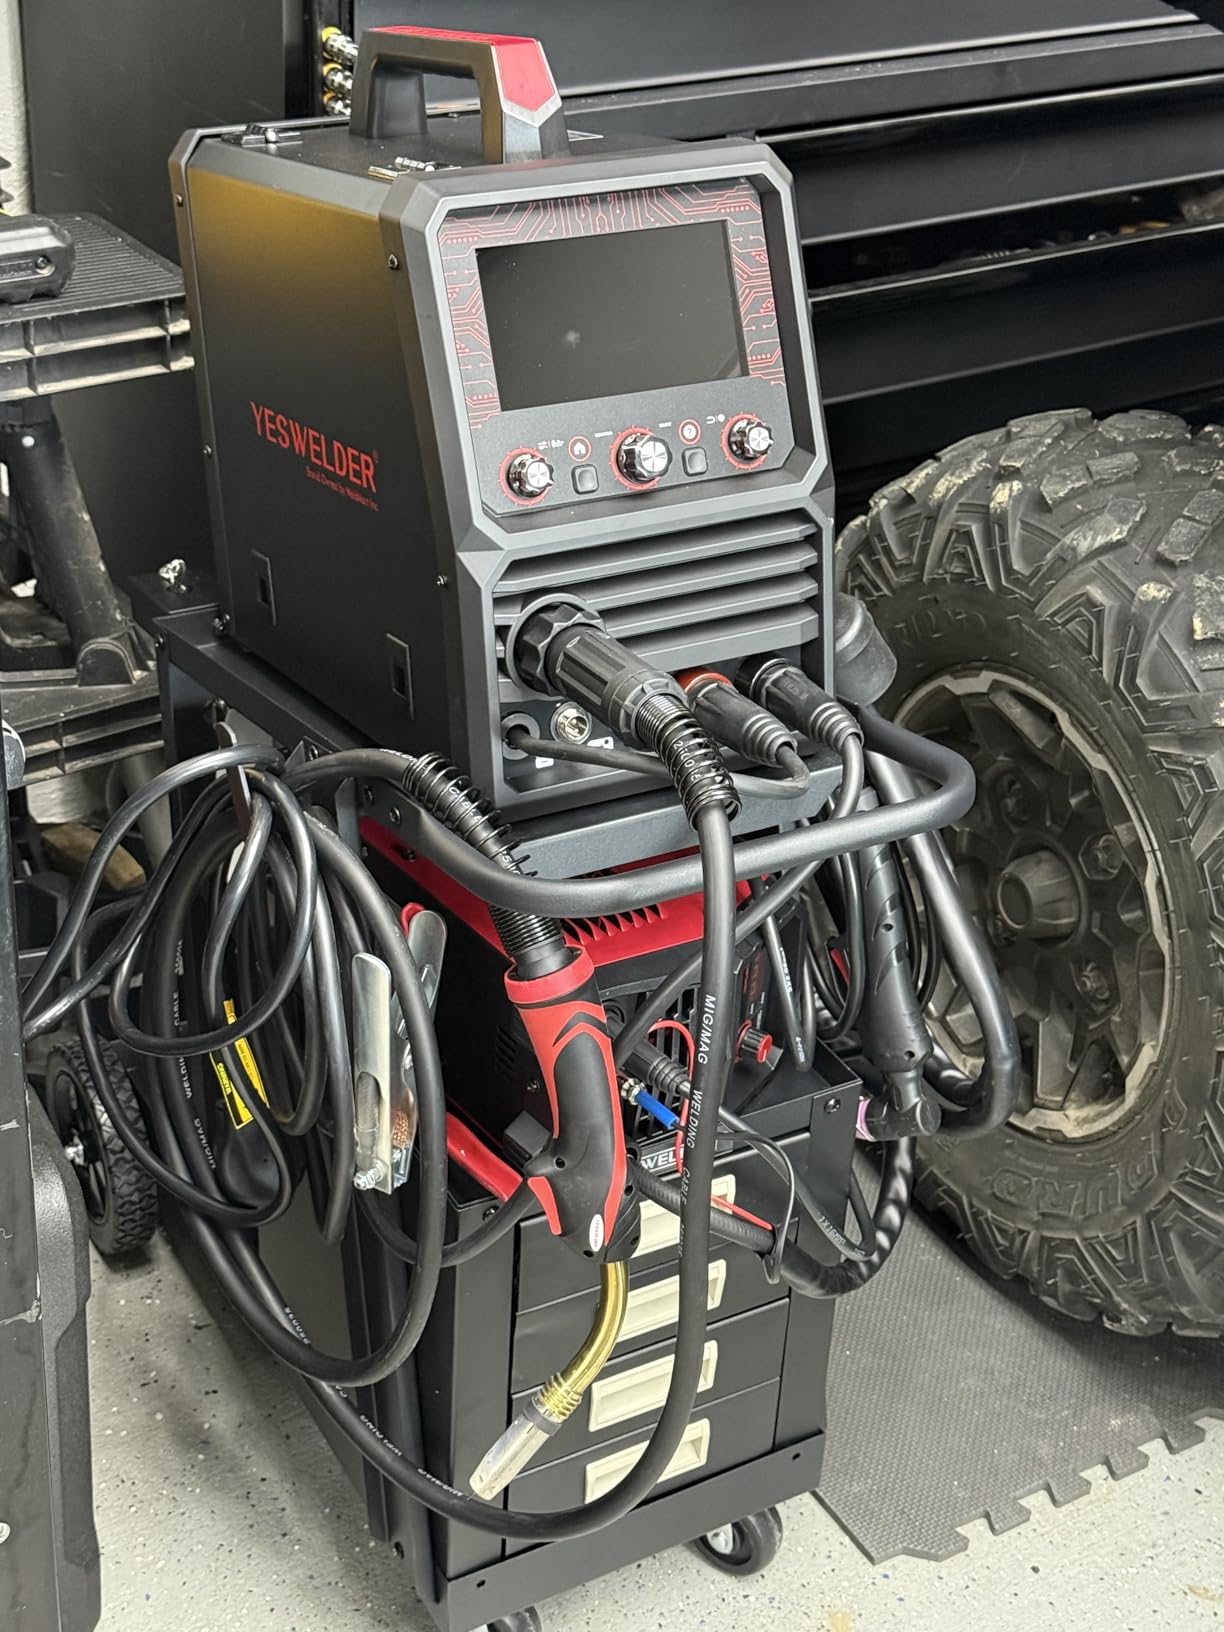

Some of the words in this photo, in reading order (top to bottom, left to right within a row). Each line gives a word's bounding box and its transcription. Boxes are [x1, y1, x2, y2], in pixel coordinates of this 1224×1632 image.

[249, 400, 377, 493] YESWELDER
[698, 994, 716, 1065] MIG/MAG
[686, 1089, 703, 1149] WELDING
[640, 1149, 684, 1170] WEL
[679, 1167, 691, 1206] CABLE
